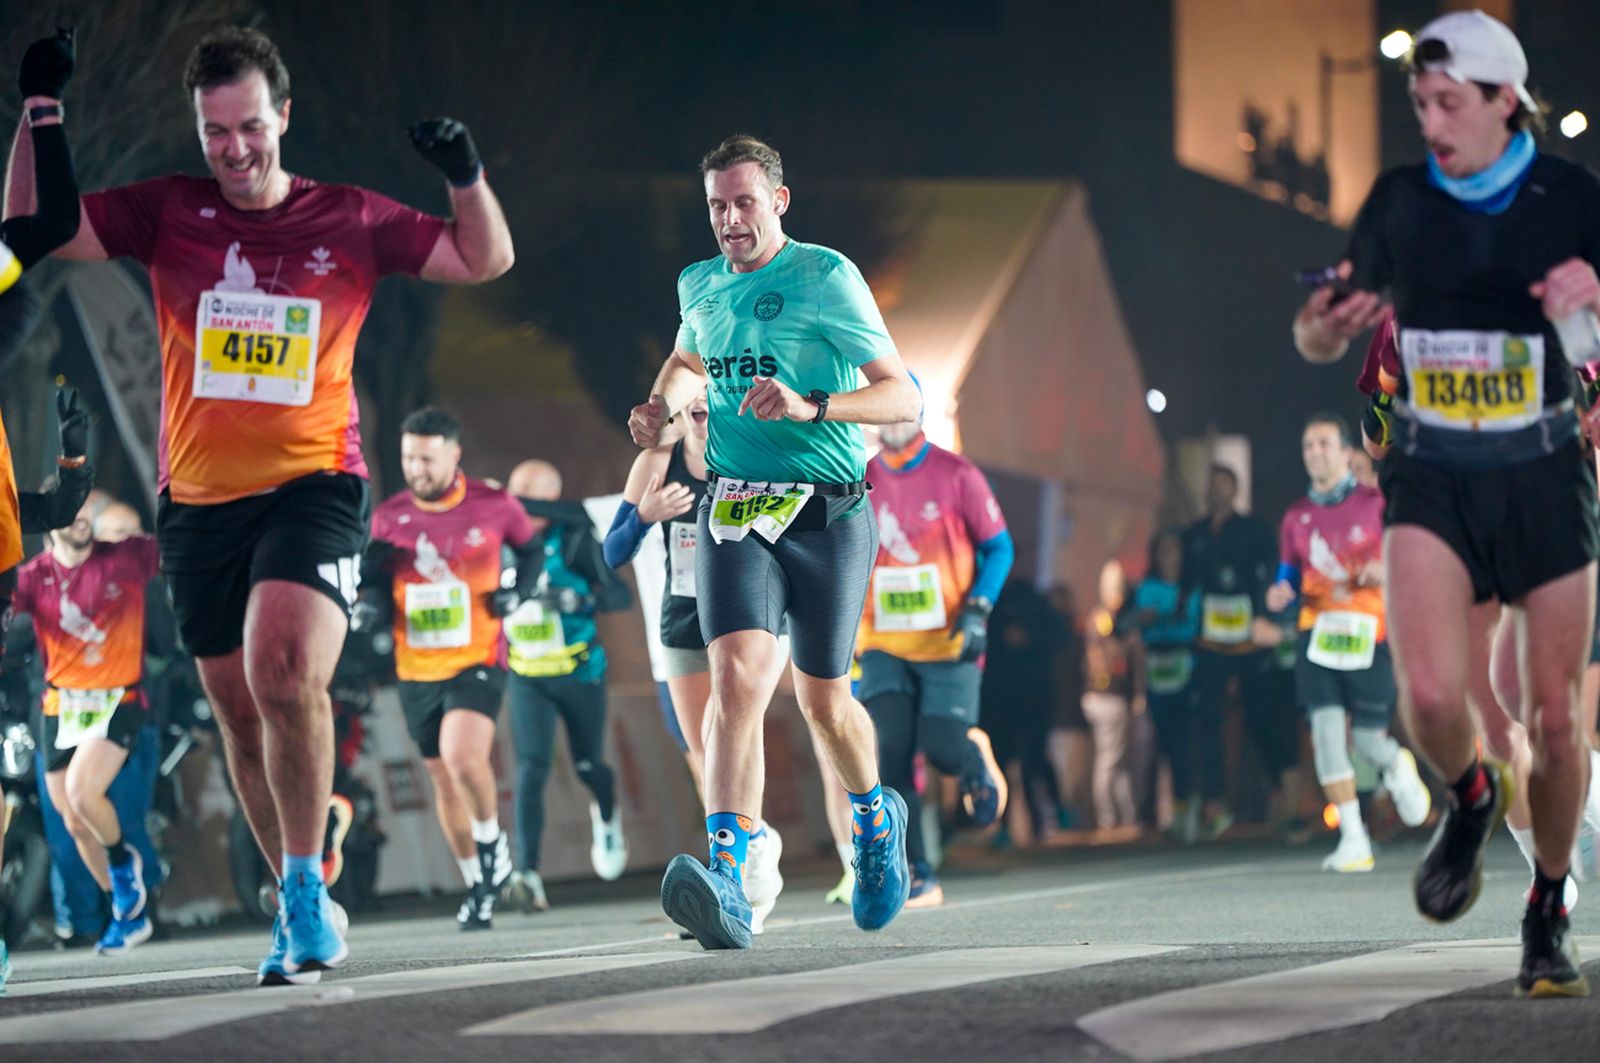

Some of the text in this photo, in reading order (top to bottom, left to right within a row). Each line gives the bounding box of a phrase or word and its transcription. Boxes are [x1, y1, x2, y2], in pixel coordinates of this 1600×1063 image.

[225, 306, 258, 317] NOCHE
[262, 307, 274, 318] DE
[211, 316, 234, 328] SAN
[222, 332, 290, 367] 4157
[730, 495, 785, 520] 6152
